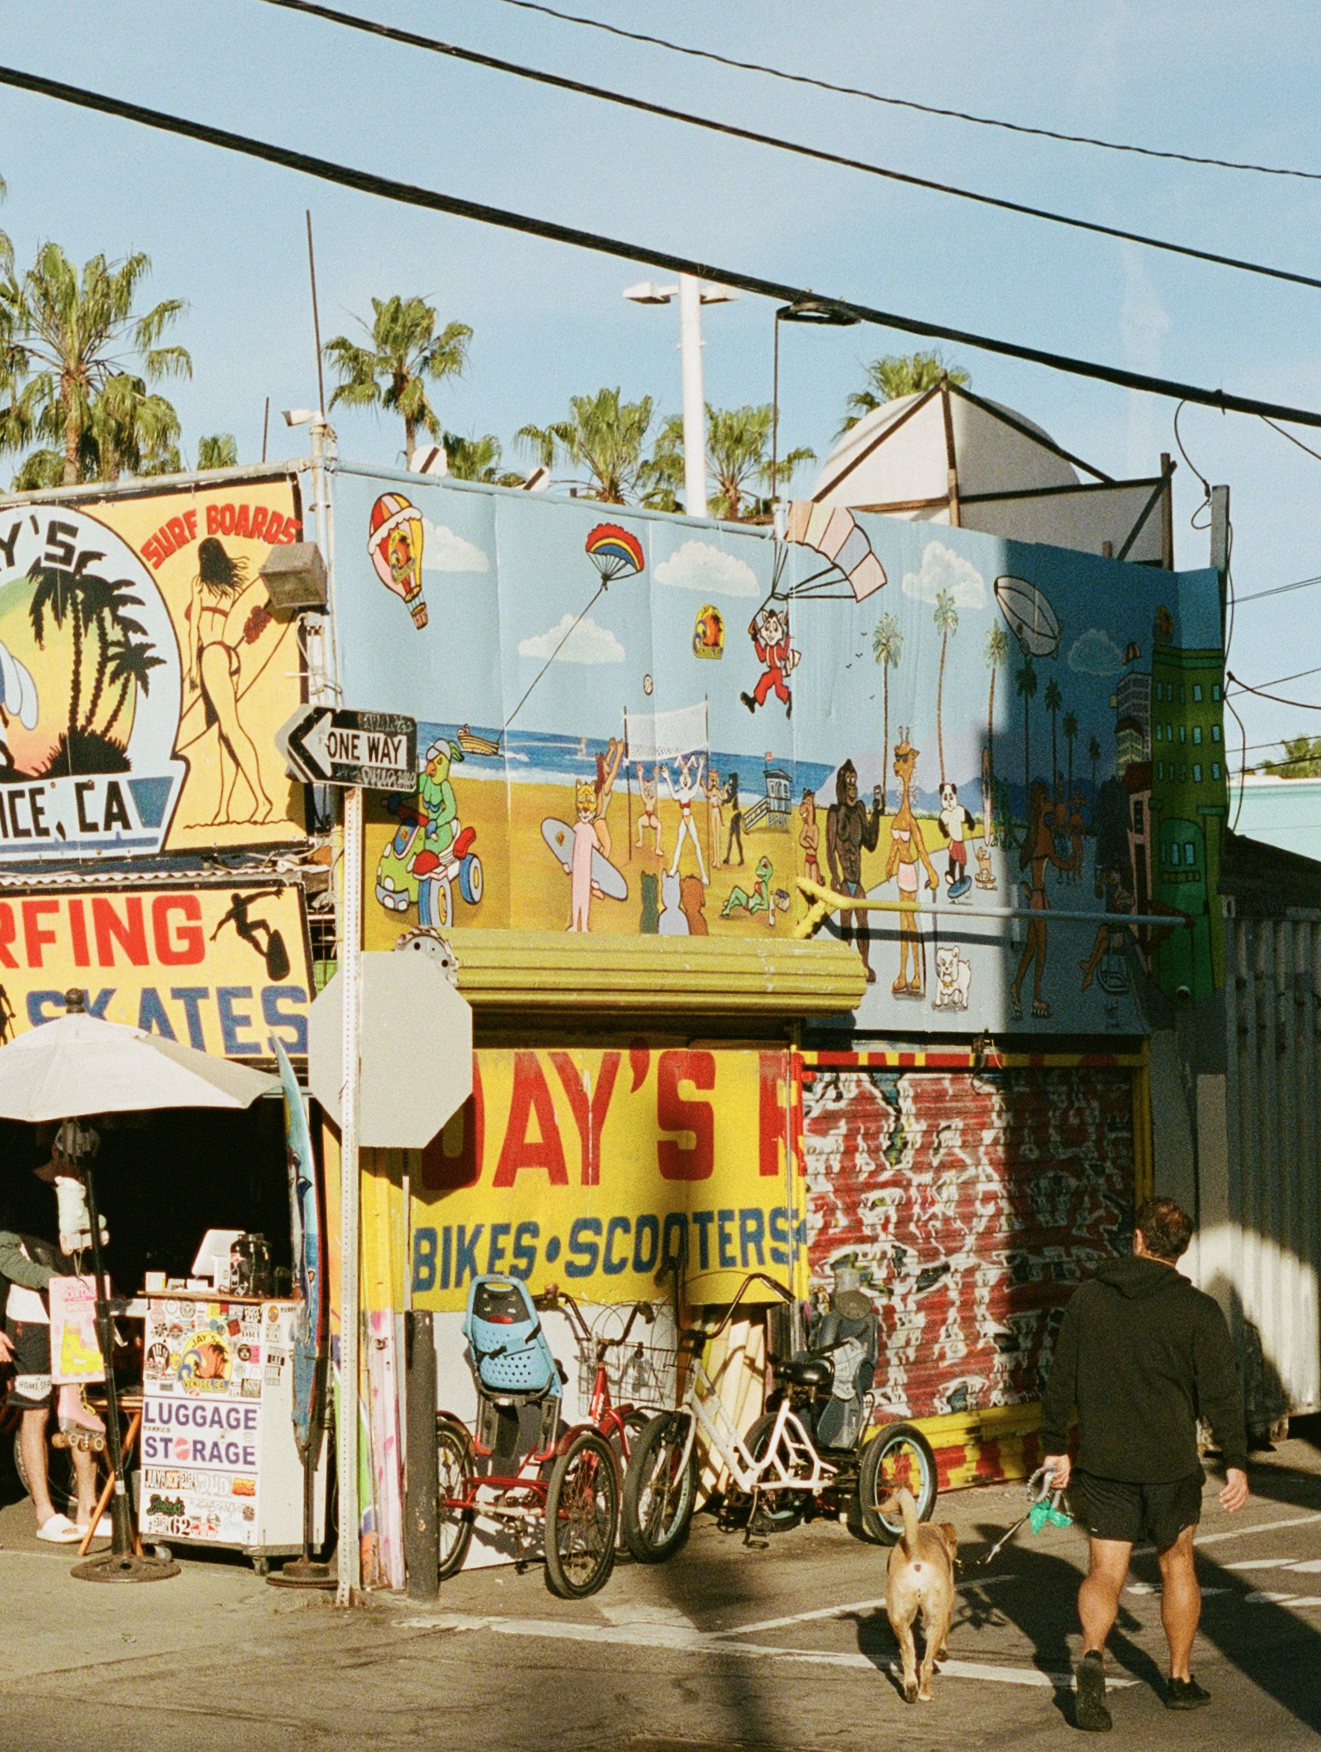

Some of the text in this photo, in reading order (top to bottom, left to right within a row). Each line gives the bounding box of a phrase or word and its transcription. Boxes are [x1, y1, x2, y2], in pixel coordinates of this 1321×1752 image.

[140, 503, 303, 570] SURF BOARDS
[328, 731, 402, 765] ONE WAY
[78, 779, 133, 834] CA
[412, 1206, 799, 1294] BIKES SCOOTERS
[192, 1334, 220, 1348] JAY'S
[19, 1381, 38, 1391] HOME
[144, 1402, 257, 1431] LUGGAGE
